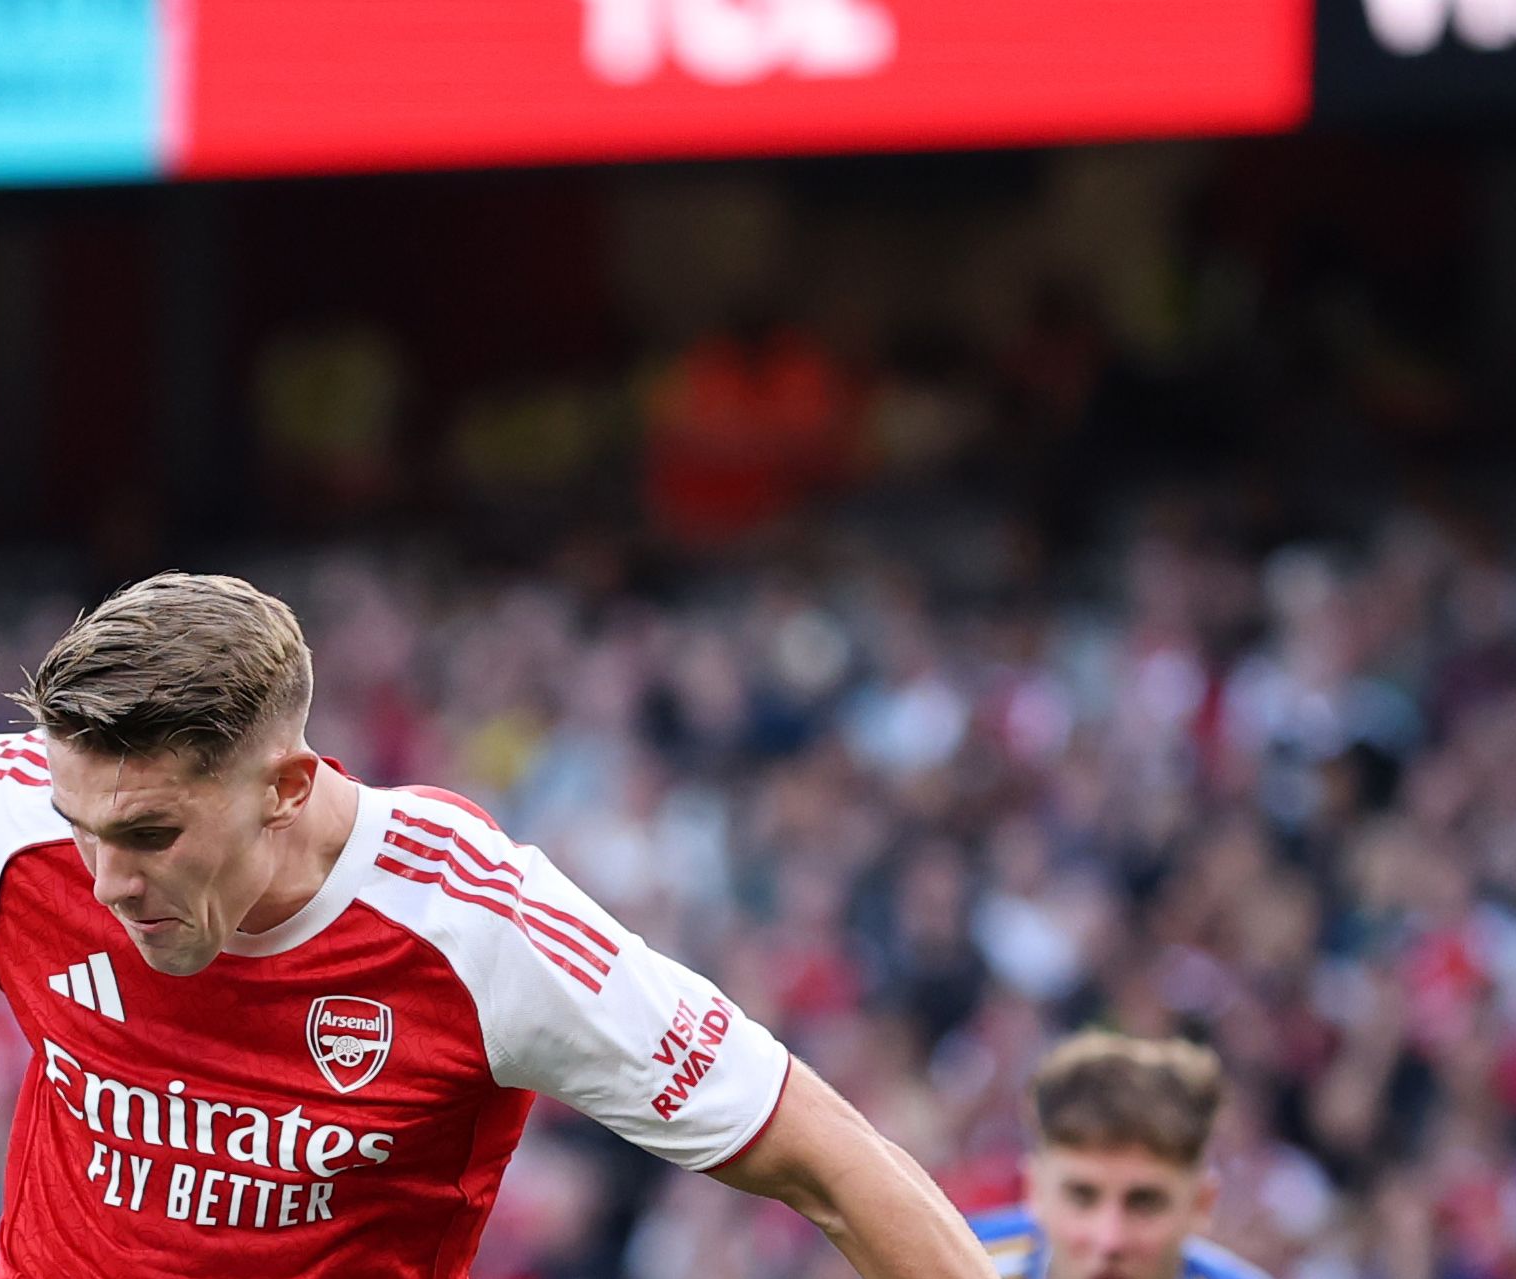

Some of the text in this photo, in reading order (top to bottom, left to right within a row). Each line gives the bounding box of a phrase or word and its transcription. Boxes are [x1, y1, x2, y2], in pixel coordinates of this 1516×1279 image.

[319, 1010, 381, 1032] Arsenal
[650, 996, 734, 1122] RWANDA
[651, 998, 698, 1066] VISIT
[43, 1037, 394, 1178] Emirates
[87, 1140, 334, 1228] FLY BETTER
